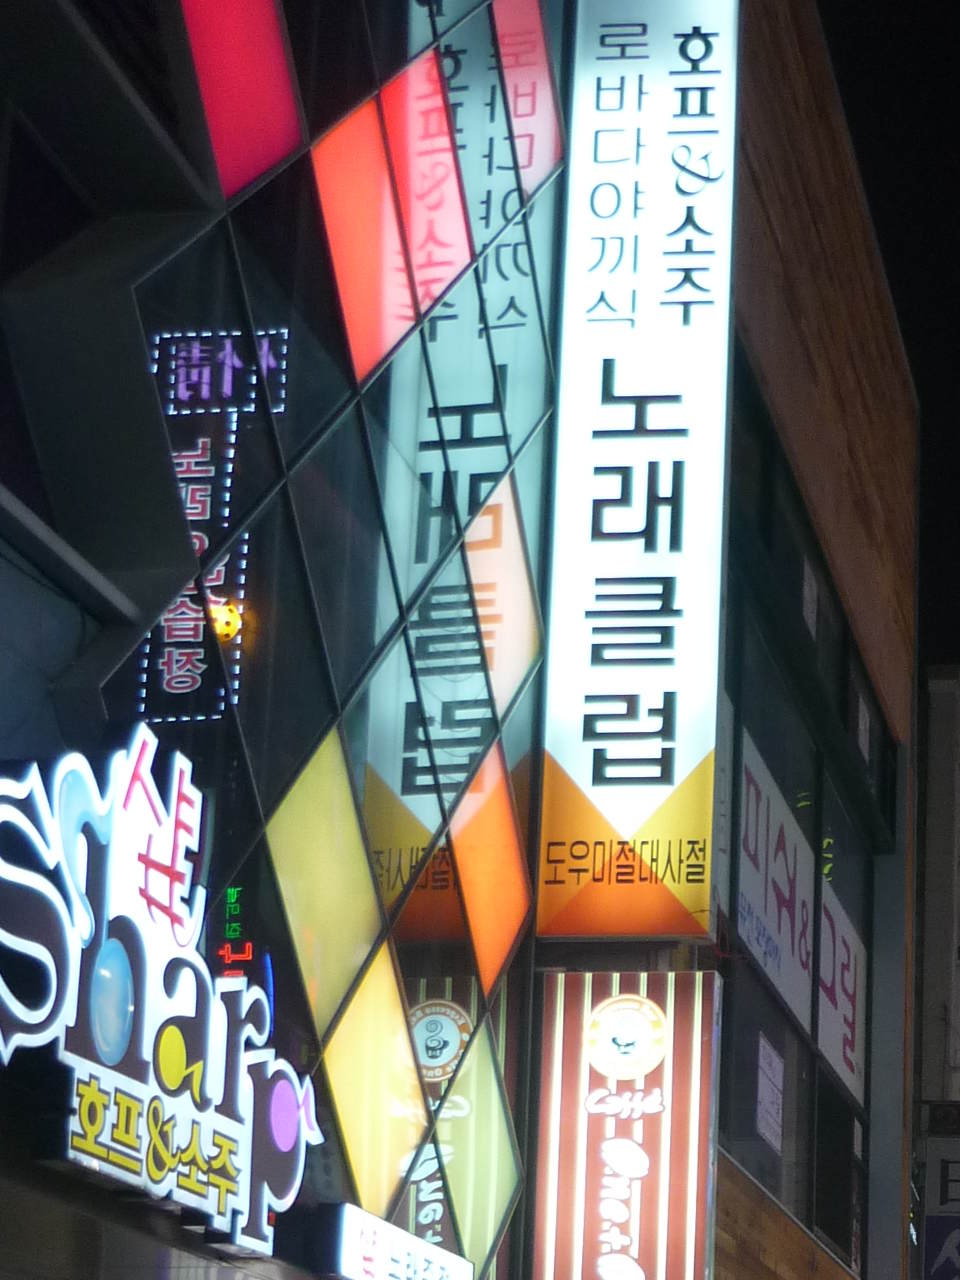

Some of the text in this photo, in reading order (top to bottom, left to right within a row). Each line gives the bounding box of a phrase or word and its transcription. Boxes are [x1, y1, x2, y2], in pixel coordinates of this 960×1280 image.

[660, 25, 725, 328] 호프&소주
[583, 357, 690, 786] 노래클럽
[544, 838, 707, 887] 도우미절대사절
[71, 1079, 241, 1215] 호프&소주
